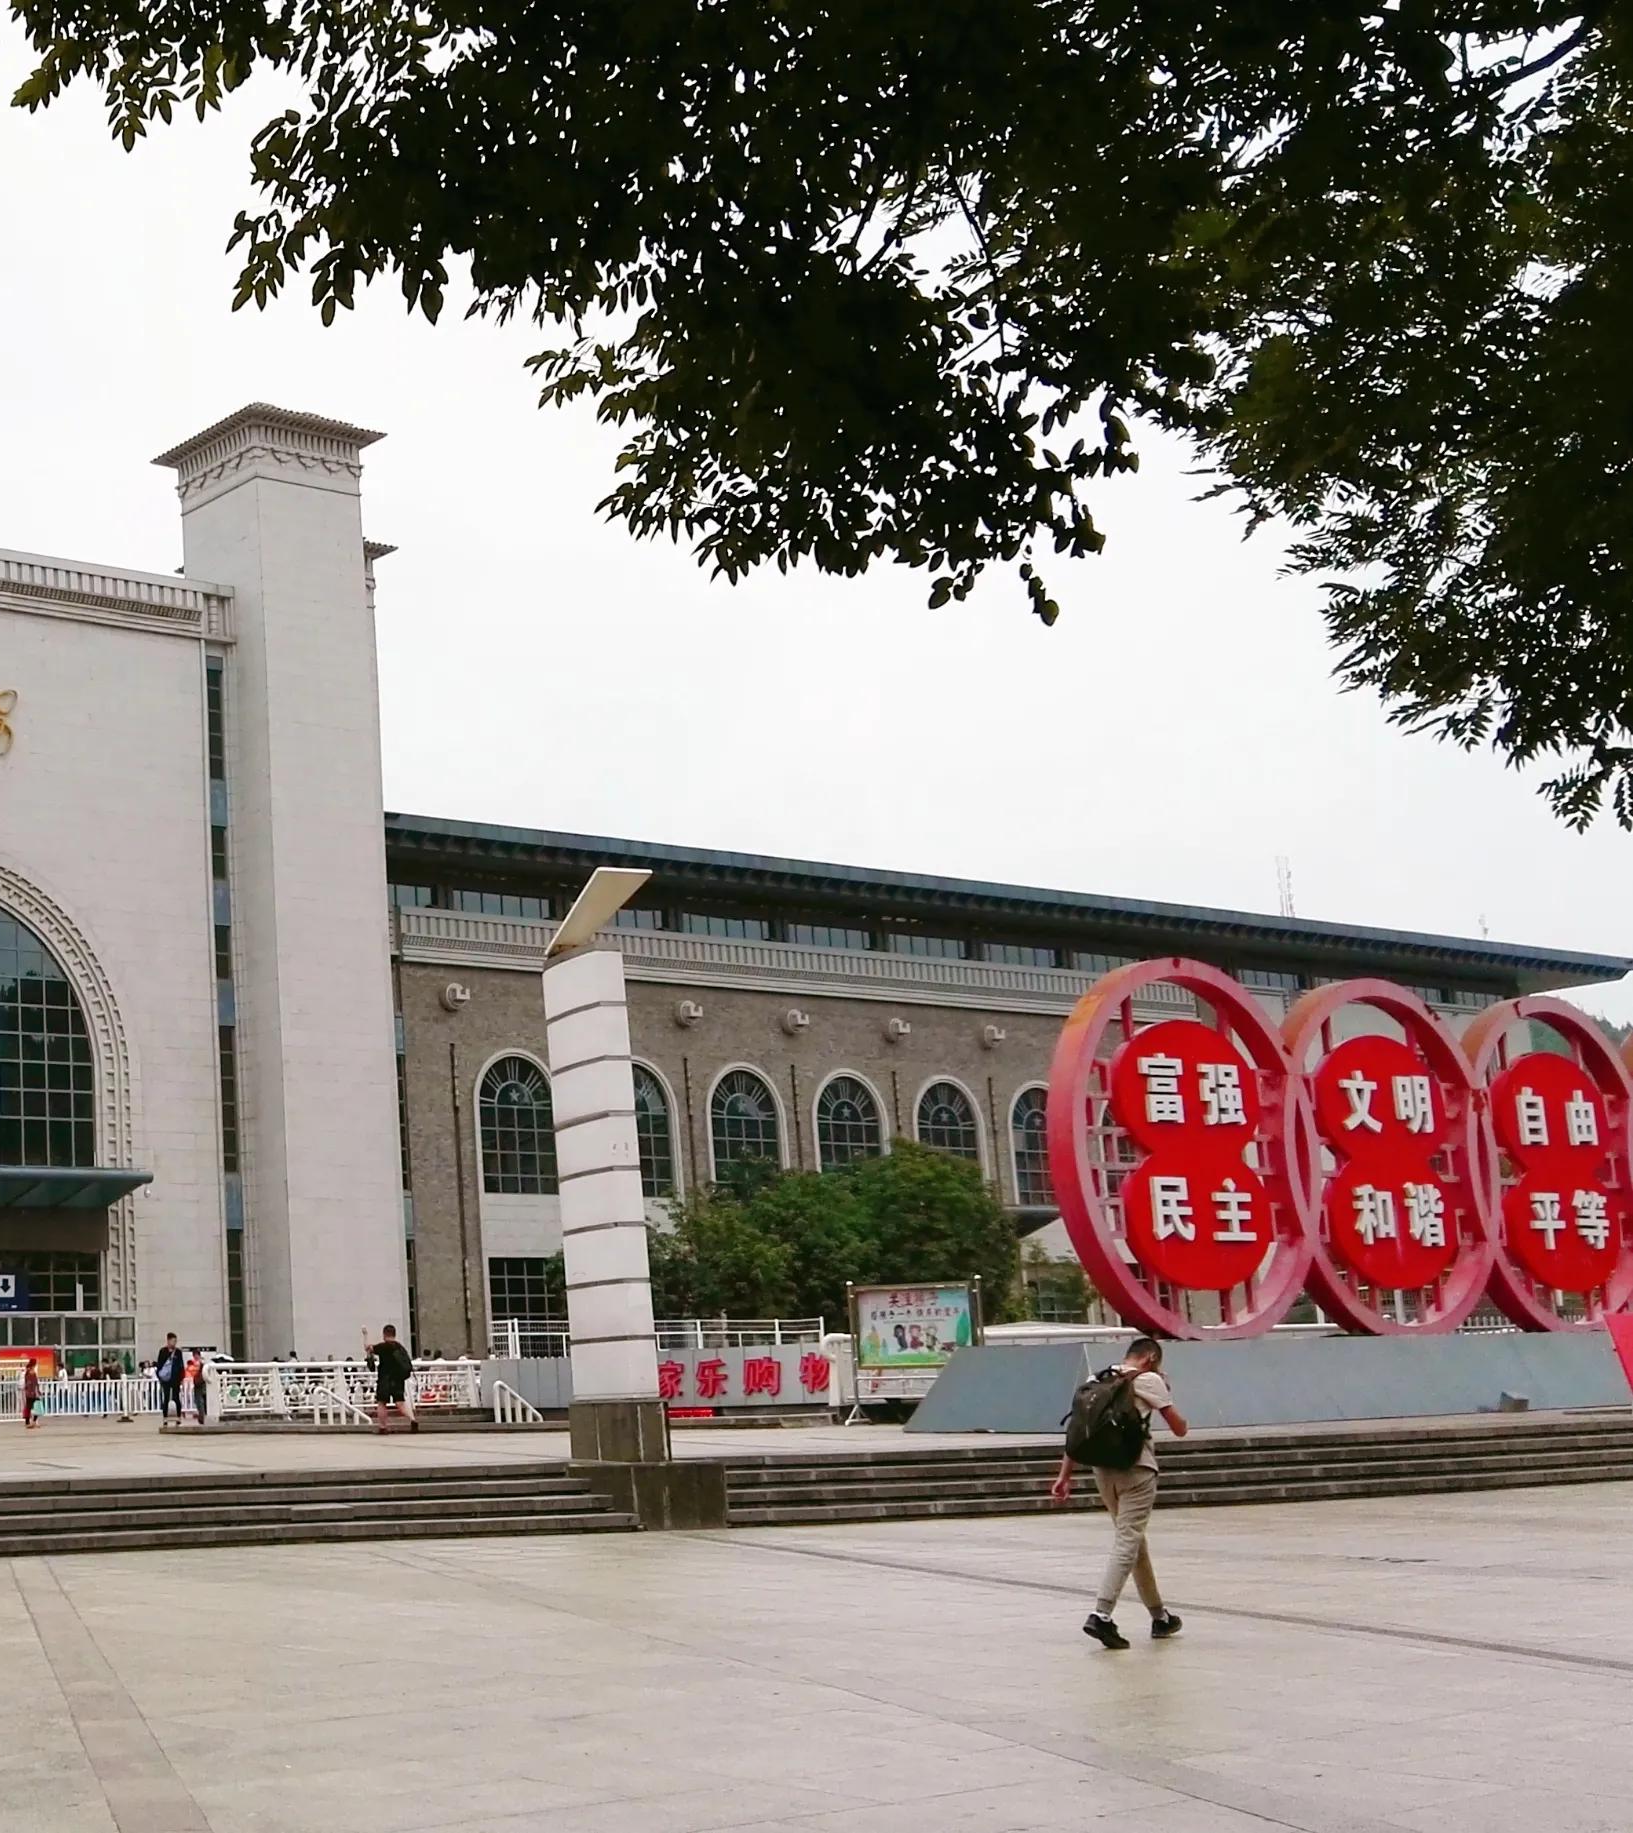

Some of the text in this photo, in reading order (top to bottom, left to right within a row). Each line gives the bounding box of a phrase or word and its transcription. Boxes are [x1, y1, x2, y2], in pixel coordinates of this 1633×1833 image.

[1137, 1053, 1248, 1126] 富强
[1338, 1070, 1436, 1134] 文明
[1515, 1087, 1599, 1147] 自由
[1149, 1176, 1257, 1243] 民主
[1352, 1181, 1446, 1248] 和谐
[1530, 1189, 1610, 1251] 平等
[658, 1352, 830, 1399] 家乐购物
